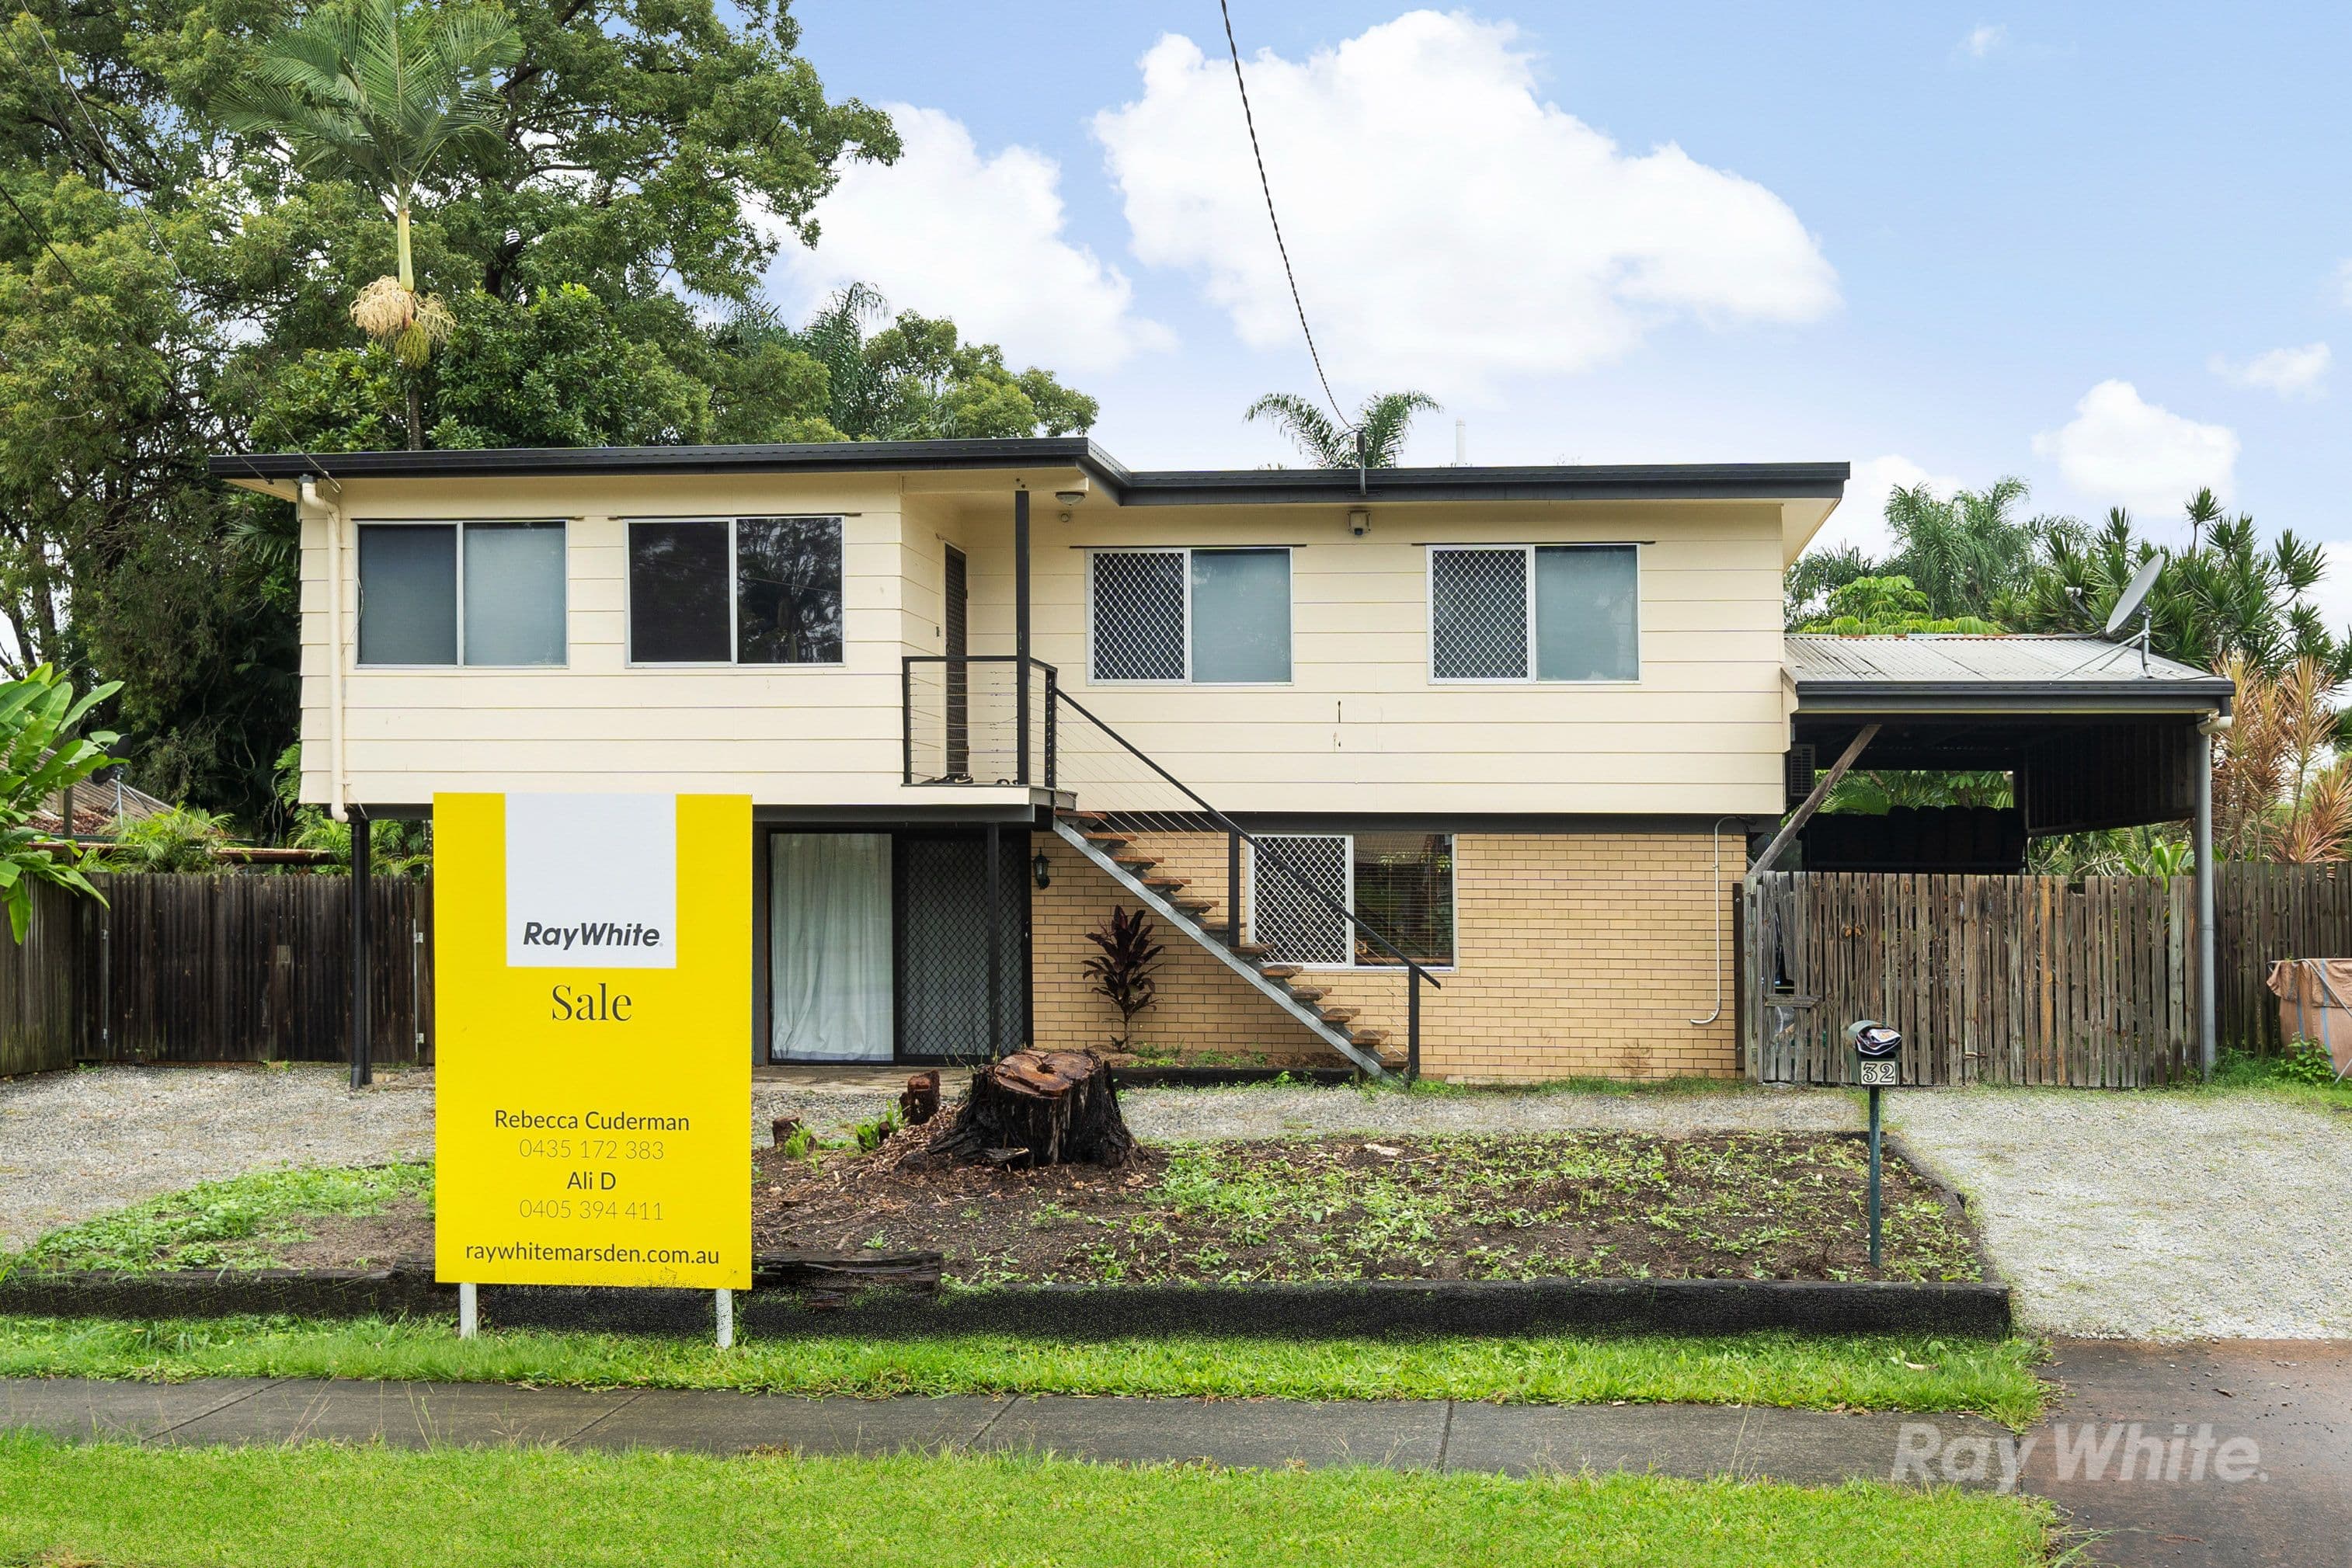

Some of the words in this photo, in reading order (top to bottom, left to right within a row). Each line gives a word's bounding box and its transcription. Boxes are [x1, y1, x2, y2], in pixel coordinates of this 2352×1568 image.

[551, 982, 632, 1022] Sale
[1863, 1062, 1894, 1083] 32
[495, 1110, 579, 1128] Rebecca
[585, 1111, 690, 1131] Cuderman
[519, 1139, 572, 1159] 0435
[579, 1139, 618, 1159] 172
[625, 1140, 665, 1160] 383
[566, 1171, 593, 1190] Ali
[600, 1172, 617, 1191] D
[519, 1199, 572, 1219] 0405
[579, 1200, 618, 1220] 394
[624, 1201, 664, 1221] 411
[465, 1240, 720, 1264] raywhitemarsden.com.au
